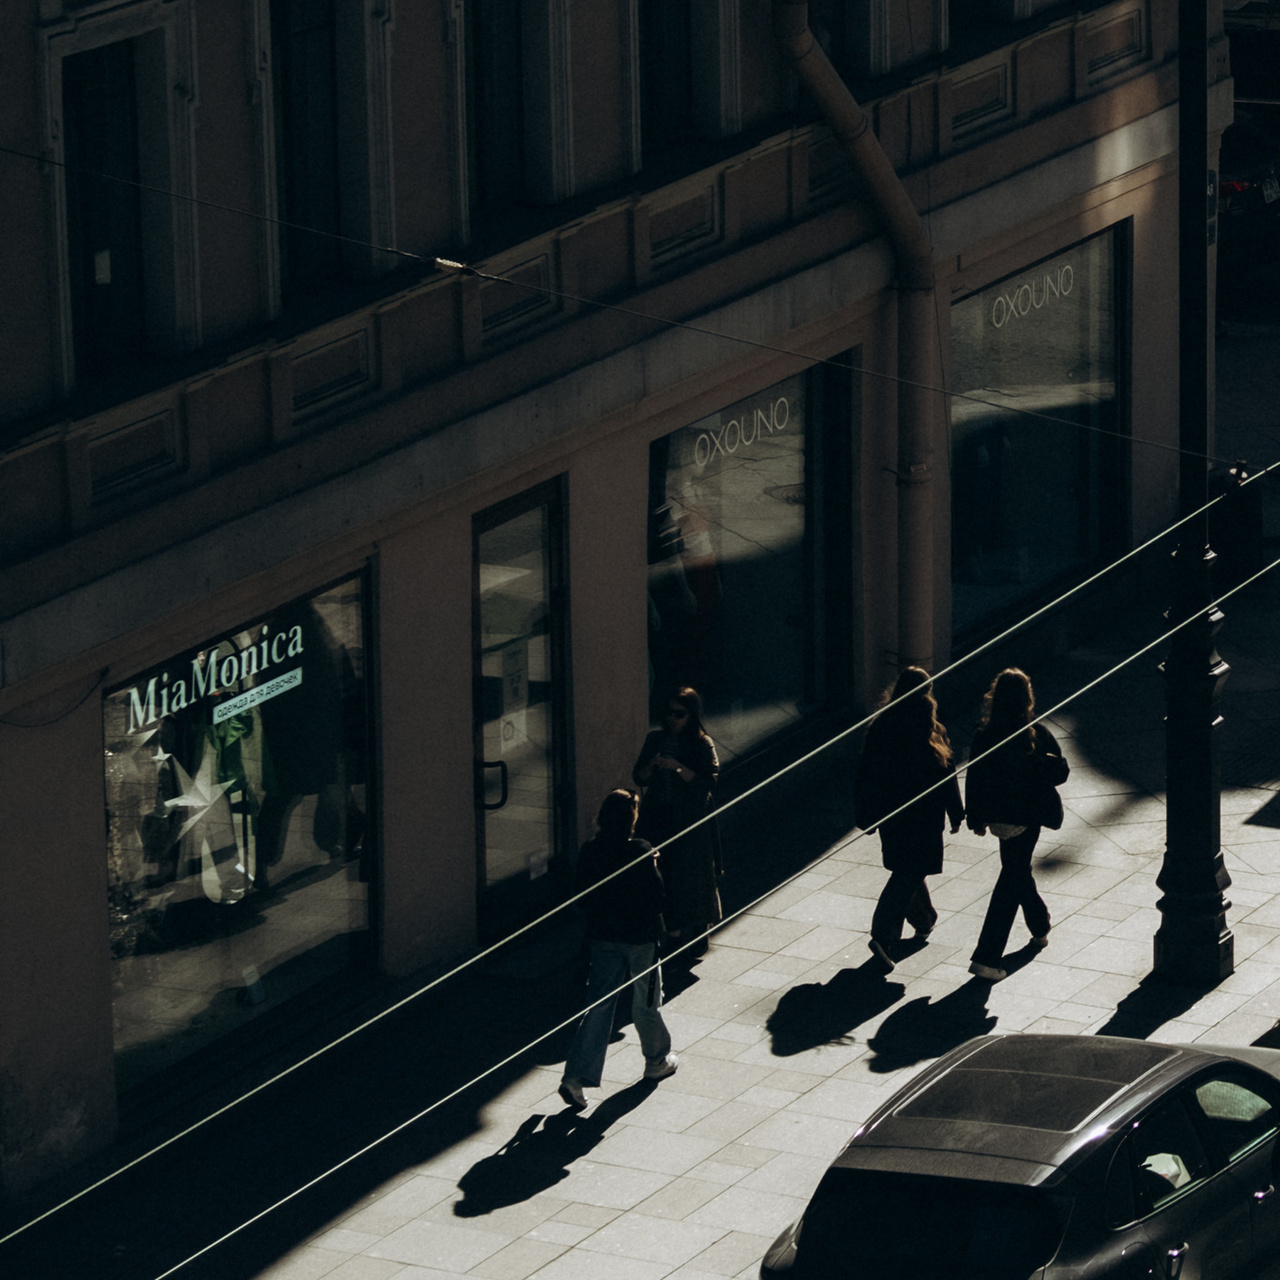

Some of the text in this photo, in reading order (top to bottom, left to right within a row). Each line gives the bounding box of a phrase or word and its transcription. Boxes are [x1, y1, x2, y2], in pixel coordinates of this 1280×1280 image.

[992, 265, 1074, 328] OXOUNO
[694, 397, 789, 467] OXOUNO
[127, 624, 304, 735] MiaMonica
[217, 673, 298, 718] одежда для девочек
